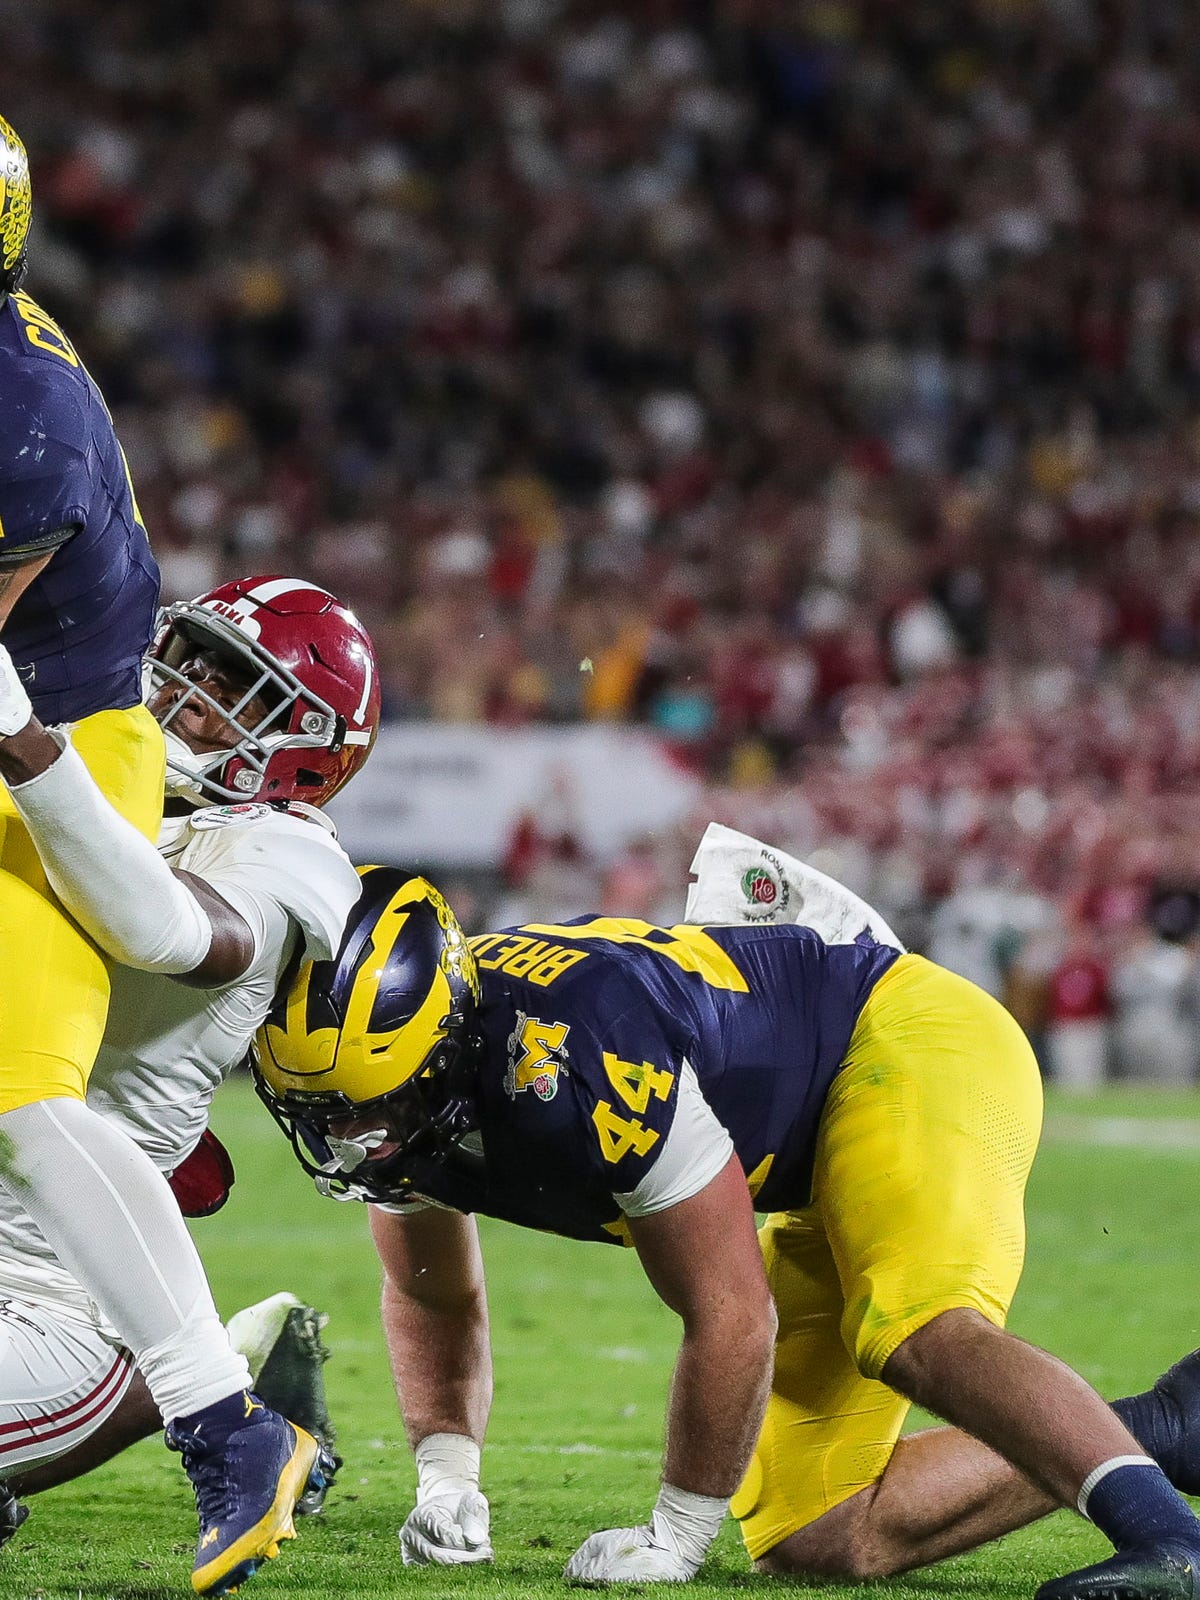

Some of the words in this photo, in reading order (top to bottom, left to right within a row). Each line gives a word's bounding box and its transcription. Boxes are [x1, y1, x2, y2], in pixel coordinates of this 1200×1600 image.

[760, 848, 785, 880] ROSE
[514, 1016, 571, 1093] M
[591, 1050, 676, 1165] 44
